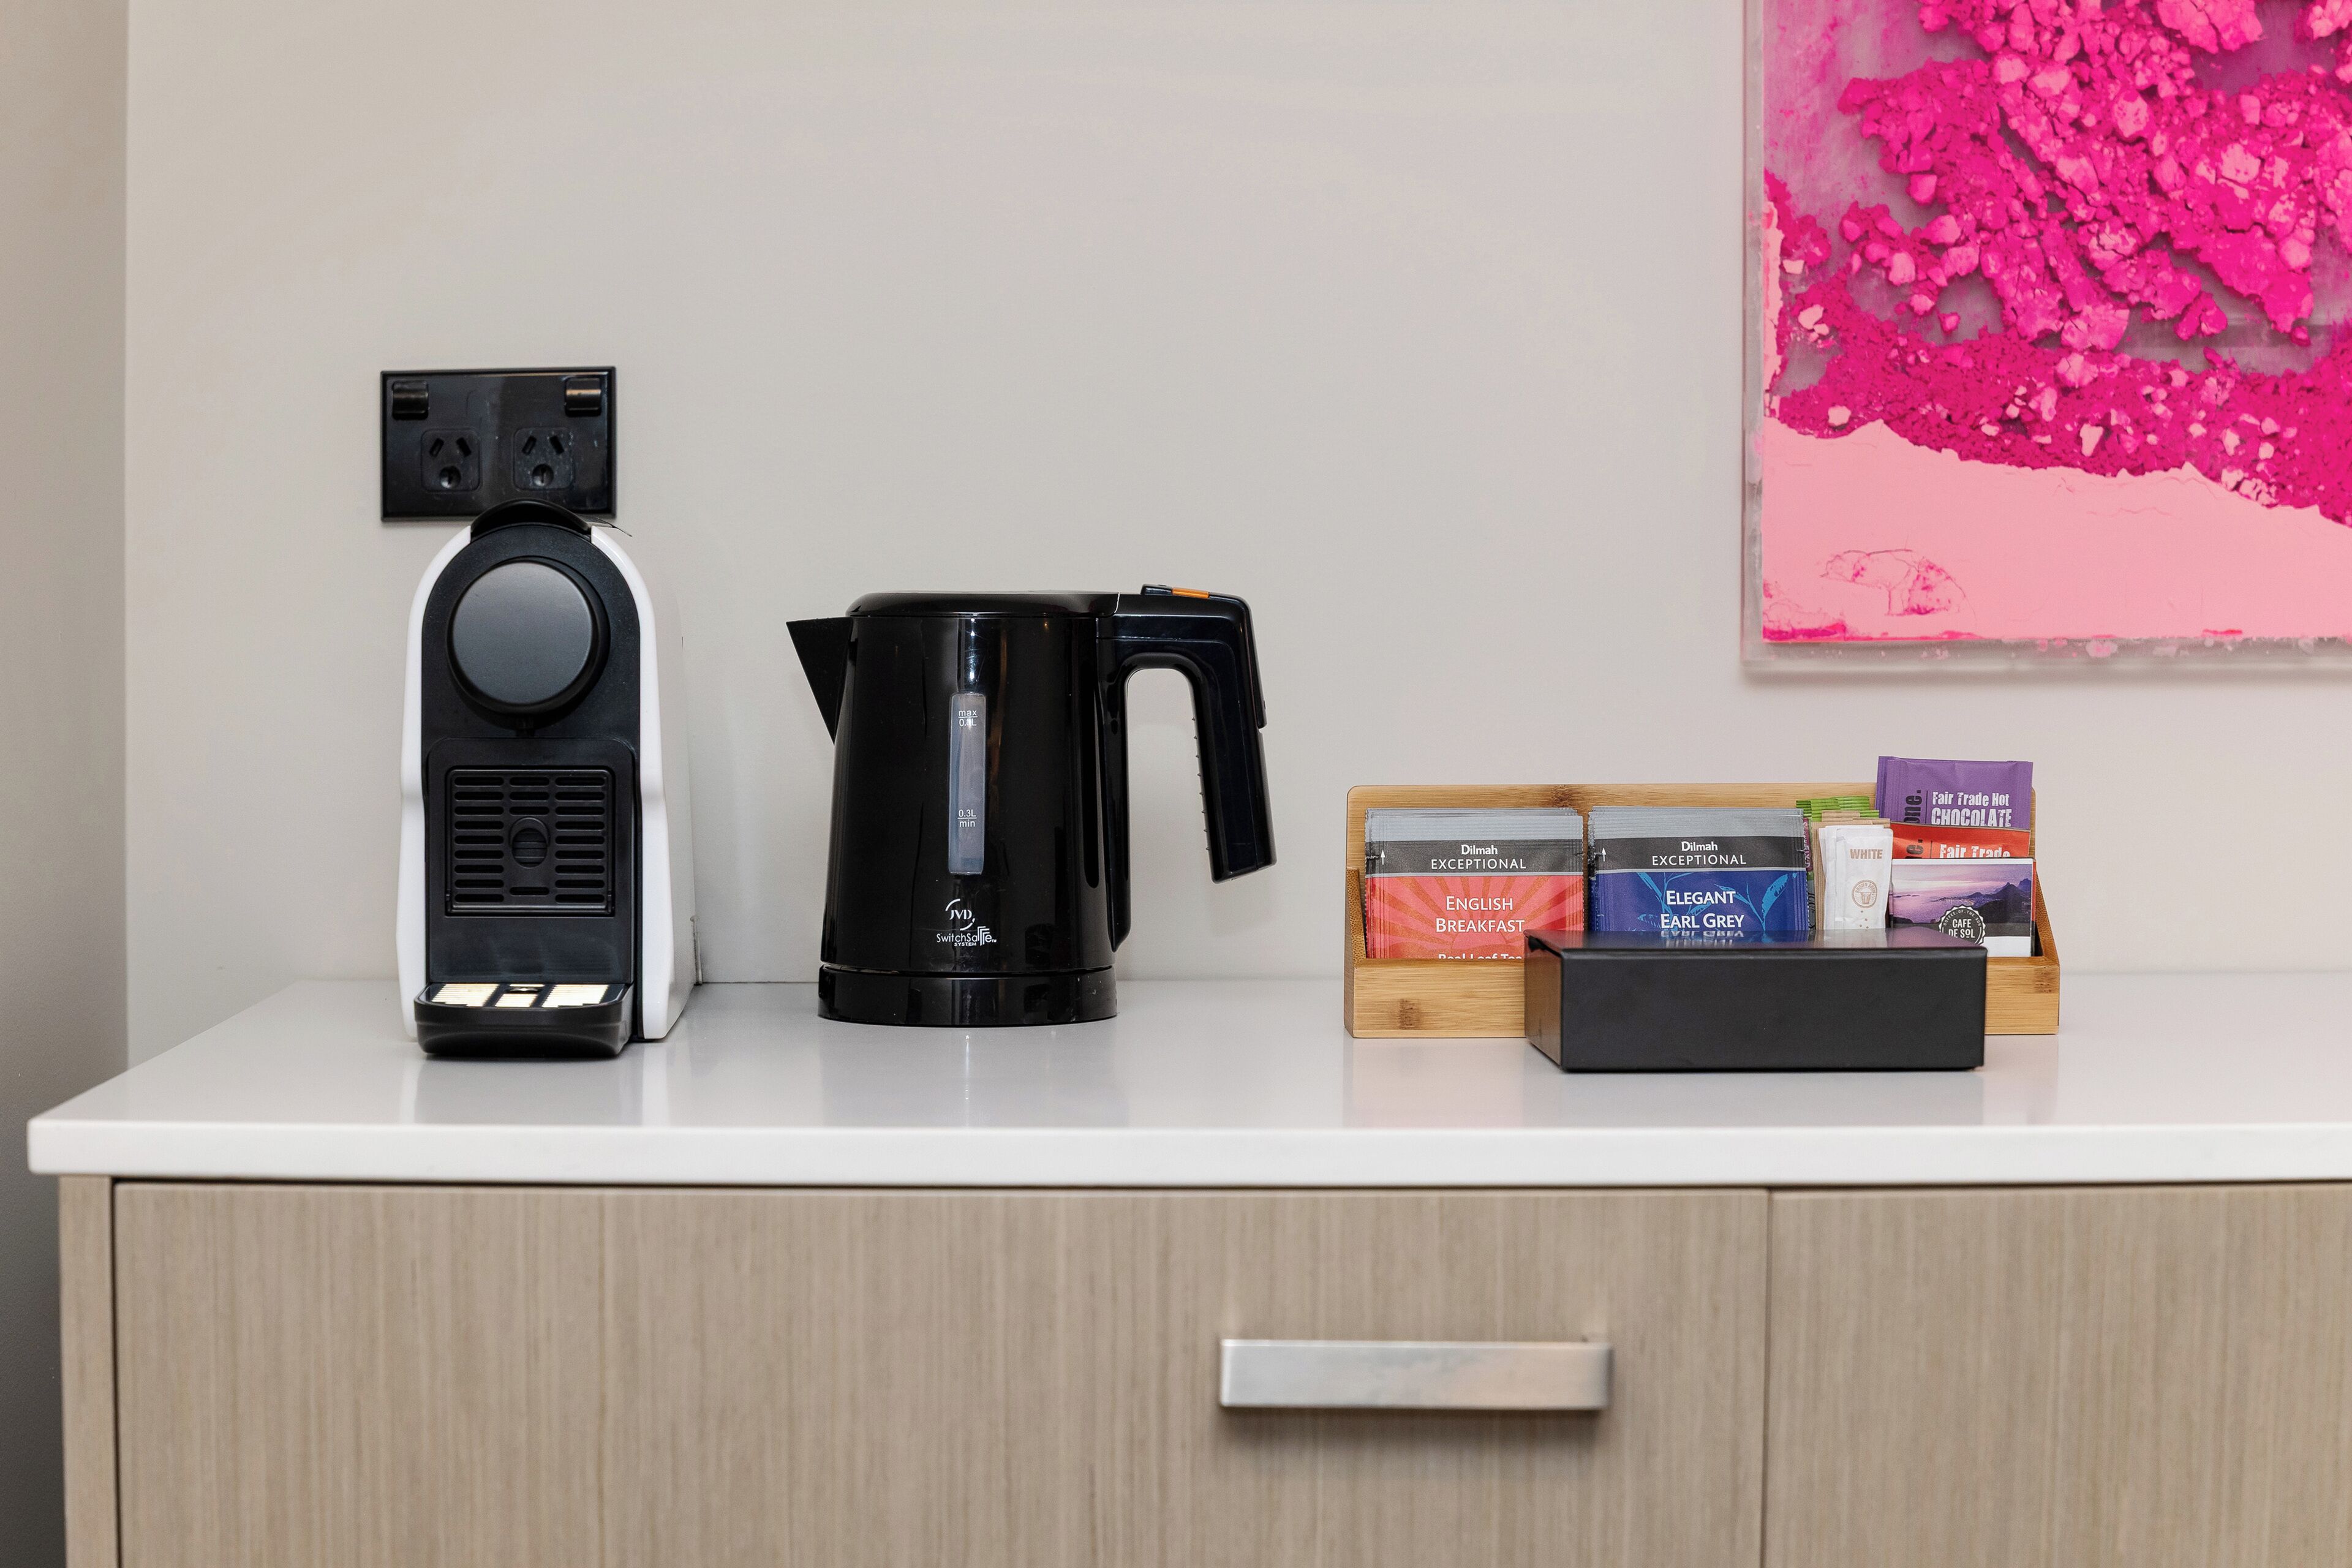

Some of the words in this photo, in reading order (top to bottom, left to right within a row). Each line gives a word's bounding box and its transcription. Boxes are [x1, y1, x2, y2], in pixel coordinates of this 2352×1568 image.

[1932, 791, 1954, 805] Fair
[1957, 792, 1989, 807] Trade
[1992, 793, 2010, 807] Hot
[959, 819, 975, 827] min
[1931, 807, 2013, 827] CHOCOLATE
[1461, 844, 1498, 855] Dilmah
[1681, 841, 1719, 851] Dilmah
[1939, 844, 1967, 858] Fair
[1652, 854, 1747, 865] EXCEPTIONAL
[1850, 848, 1883, 859] WHITE
[1431, 858, 1526, 870] EXCEPTIONAL
[1446, 895, 1513, 910] ENGLISH
[1666, 890, 1736, 905] ELEGANT
[949, 909, 973, 920] JVD
[1436, 918, 1525, 933] BREAKFAST
[1660, 913, 1700, 929] EARL
[1703, 913, 1745, 929] GREY
[1952, 919, 1972, 929] CAFE
